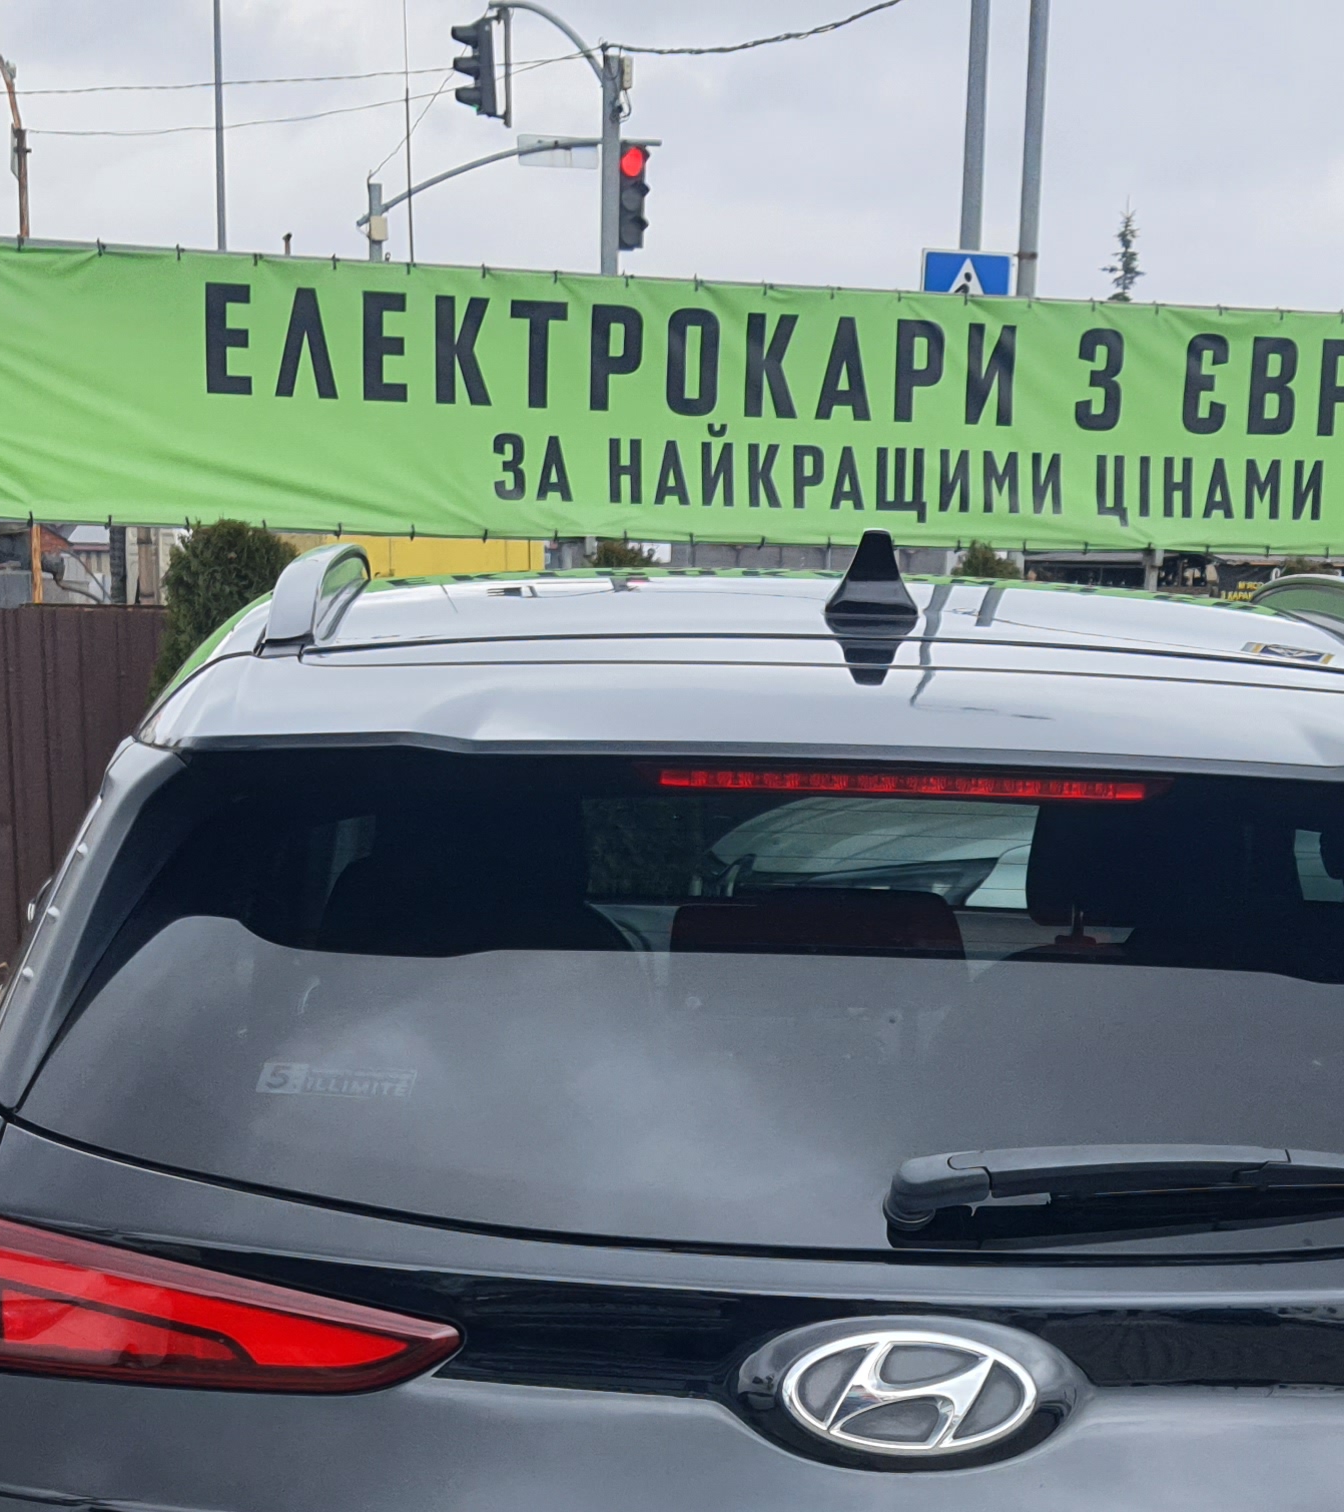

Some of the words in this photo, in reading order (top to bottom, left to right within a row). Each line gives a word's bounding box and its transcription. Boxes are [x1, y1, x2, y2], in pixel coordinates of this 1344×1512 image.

[205, 281, 1017, 427] ЕЛЕКТРОКАРИ
[1074, 328, 1125, 431] З
[492, 432, 574, 504] ЗА
[608, 422, 1063, 524] НАЙКРАЩИМИ
[1096, 454, 1324, 528] ЦІНАМИ
